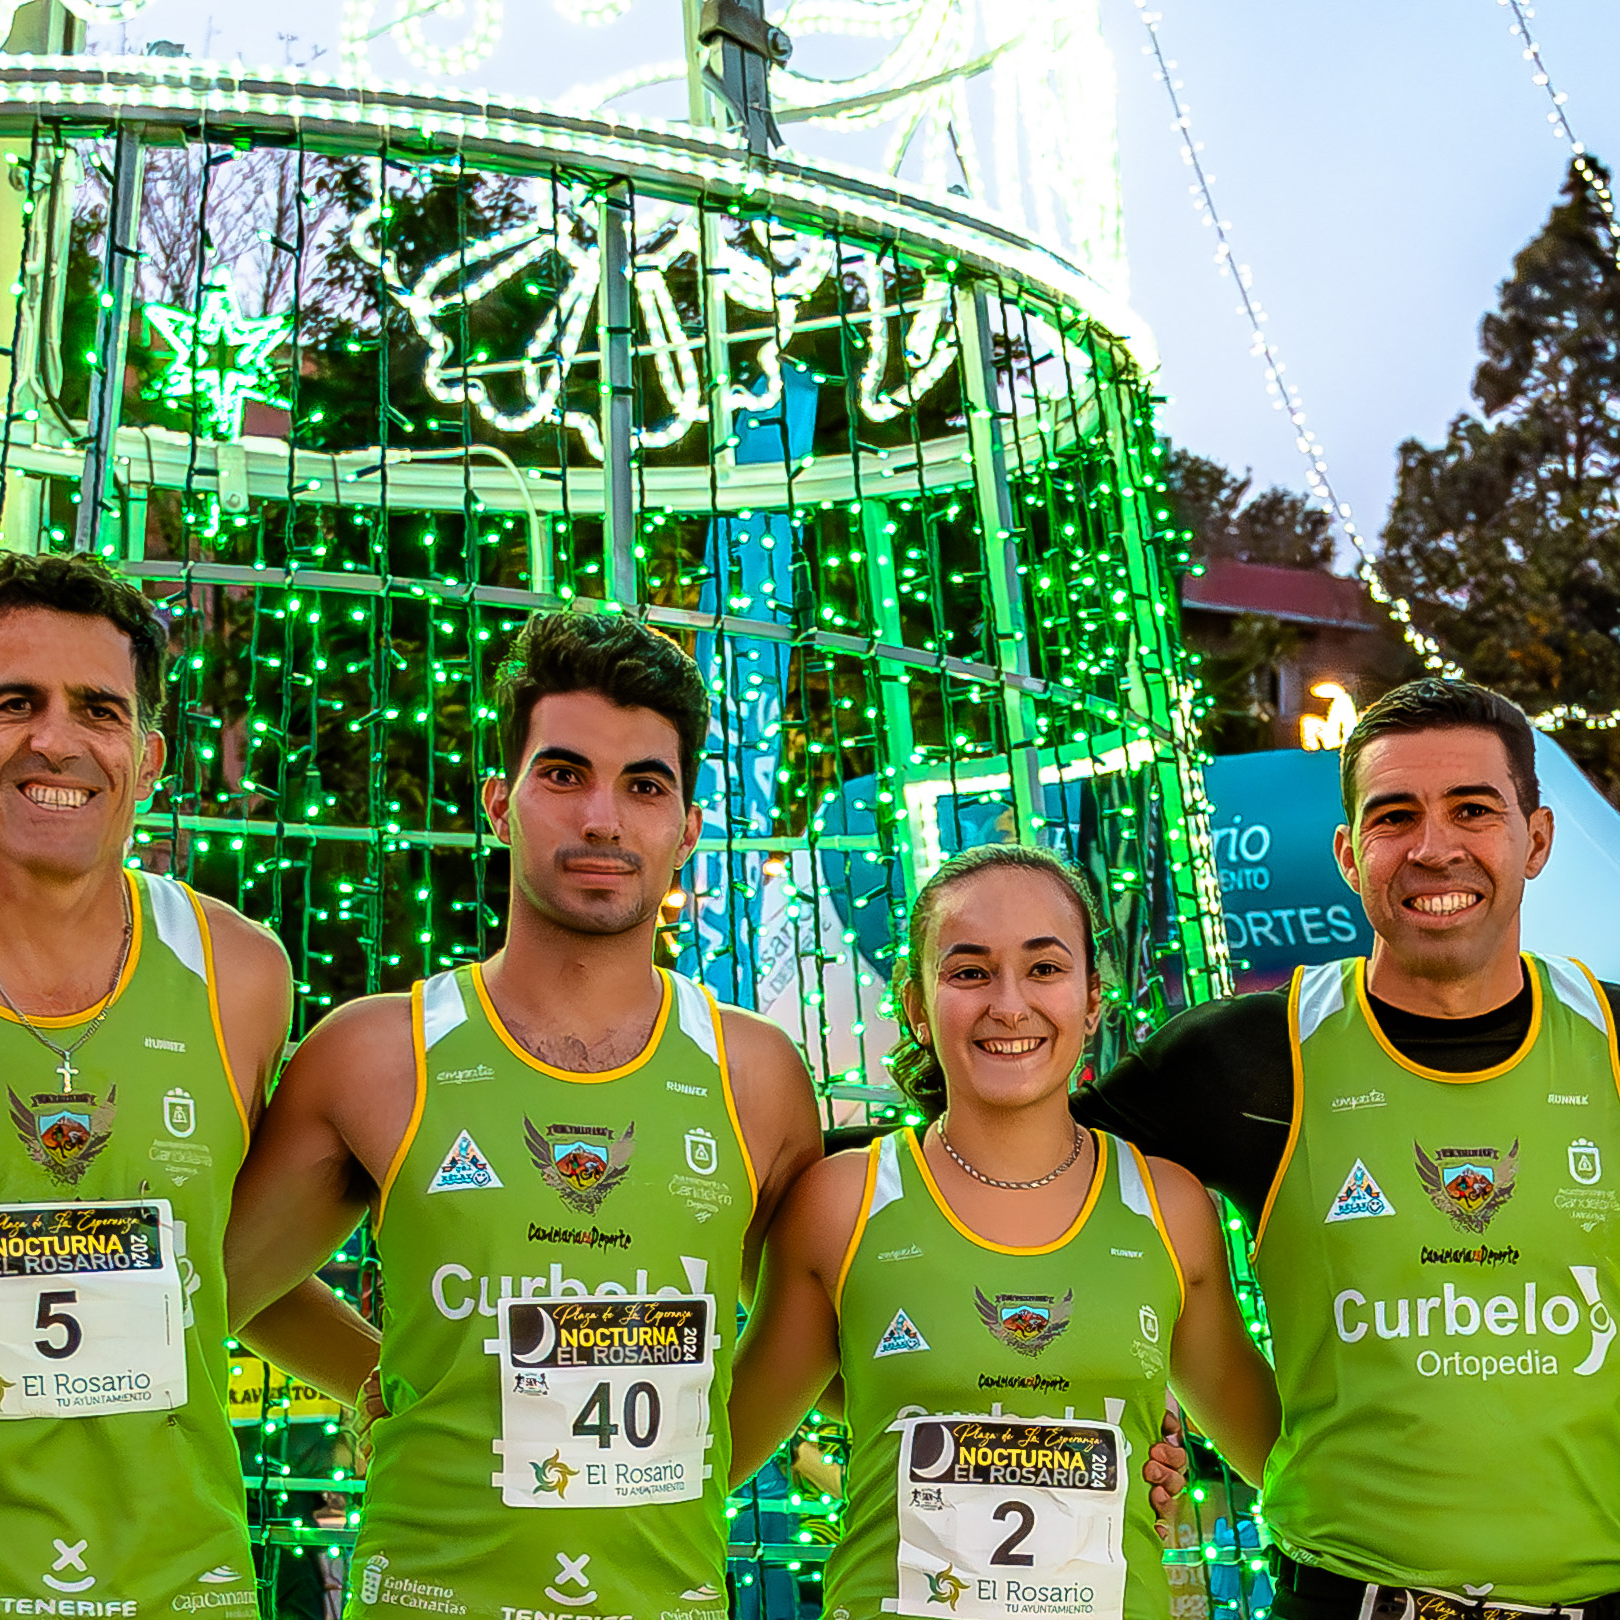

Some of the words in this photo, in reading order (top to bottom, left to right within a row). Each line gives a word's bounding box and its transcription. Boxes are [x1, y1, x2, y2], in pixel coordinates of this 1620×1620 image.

[130, 1234, 148, 1267] 2024
[26, 1253, 129, 1273] ROSARIO
[1334, 1282, 1580, 1343] Curbelo
[35, 1290, 82, 1359] 5
[561, 1327, 678, 1347] NOCTURNA
[683, 1328, 697, 1361] 2024
[558, 1347, 587, 1365] EL
[594, 1346, 681, 1364] ROSARIO
[1417, 1350, 1557, 1380] Ortopedia
[22, 1375, 44, 1396] El
[55, 1369, 150, 1395] Rosario
[56, 1398, 70, 1407] TU
[572, 1382, 660, 1449] 40
[959, 1447, 1086, 1470] NOCTURNA
[586, 1464, 607, 1484] El
[616, 1460, 684, 1484] Rosario
[954, 1465, 983, 1482] EL
[990, 1466, 1088, 1487] ROSARIO
[1091, 1454, 1107, 1488] 2024
[616, 1488, 628, 1496] TU
[990, 1501, 1035, 1566] 2
[384, 1576, 454, 1598] Gobierno
[978, 1580, 996, 1600] El
[1006, 1580, 1094, 1602] Rosario
[0, 1597, 137, 1618] TENERIFE
[381, 1590, 399, 1605] de
[400, 1593, 468, 1616] Canarias
[1005, 1604, 1019, 1613] TU
